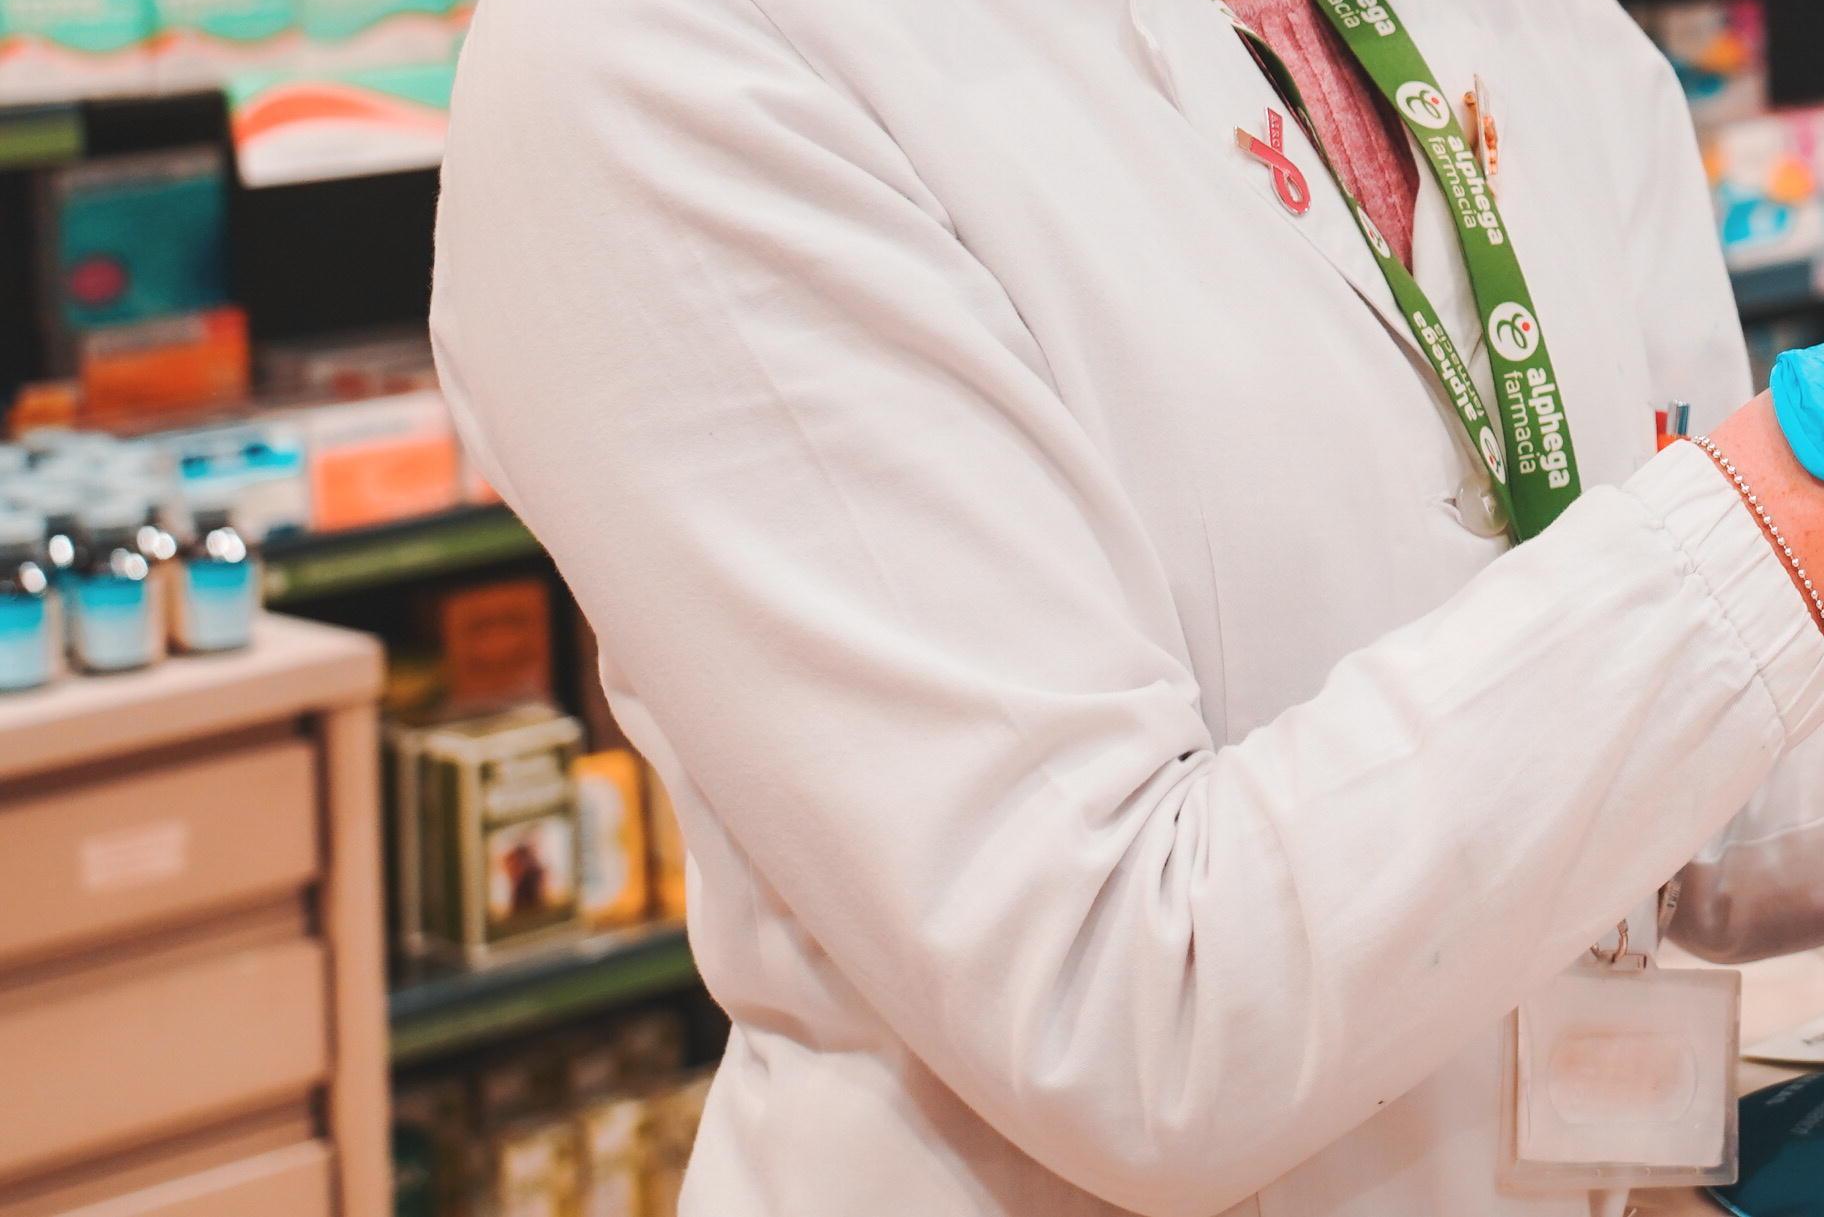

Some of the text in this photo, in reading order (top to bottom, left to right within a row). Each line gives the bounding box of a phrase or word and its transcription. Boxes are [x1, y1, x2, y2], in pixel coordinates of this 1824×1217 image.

[1428, 136, 1477, 229] farmacia
[1448, 135, 1504, 246] alphega
[1411, 309, 1478, 422] alphega
[1432, 322, 1485, 419] farmacia
[1503, 370, 1537, 475] farmacia
[1526, 367, 1571, 490] alphega
